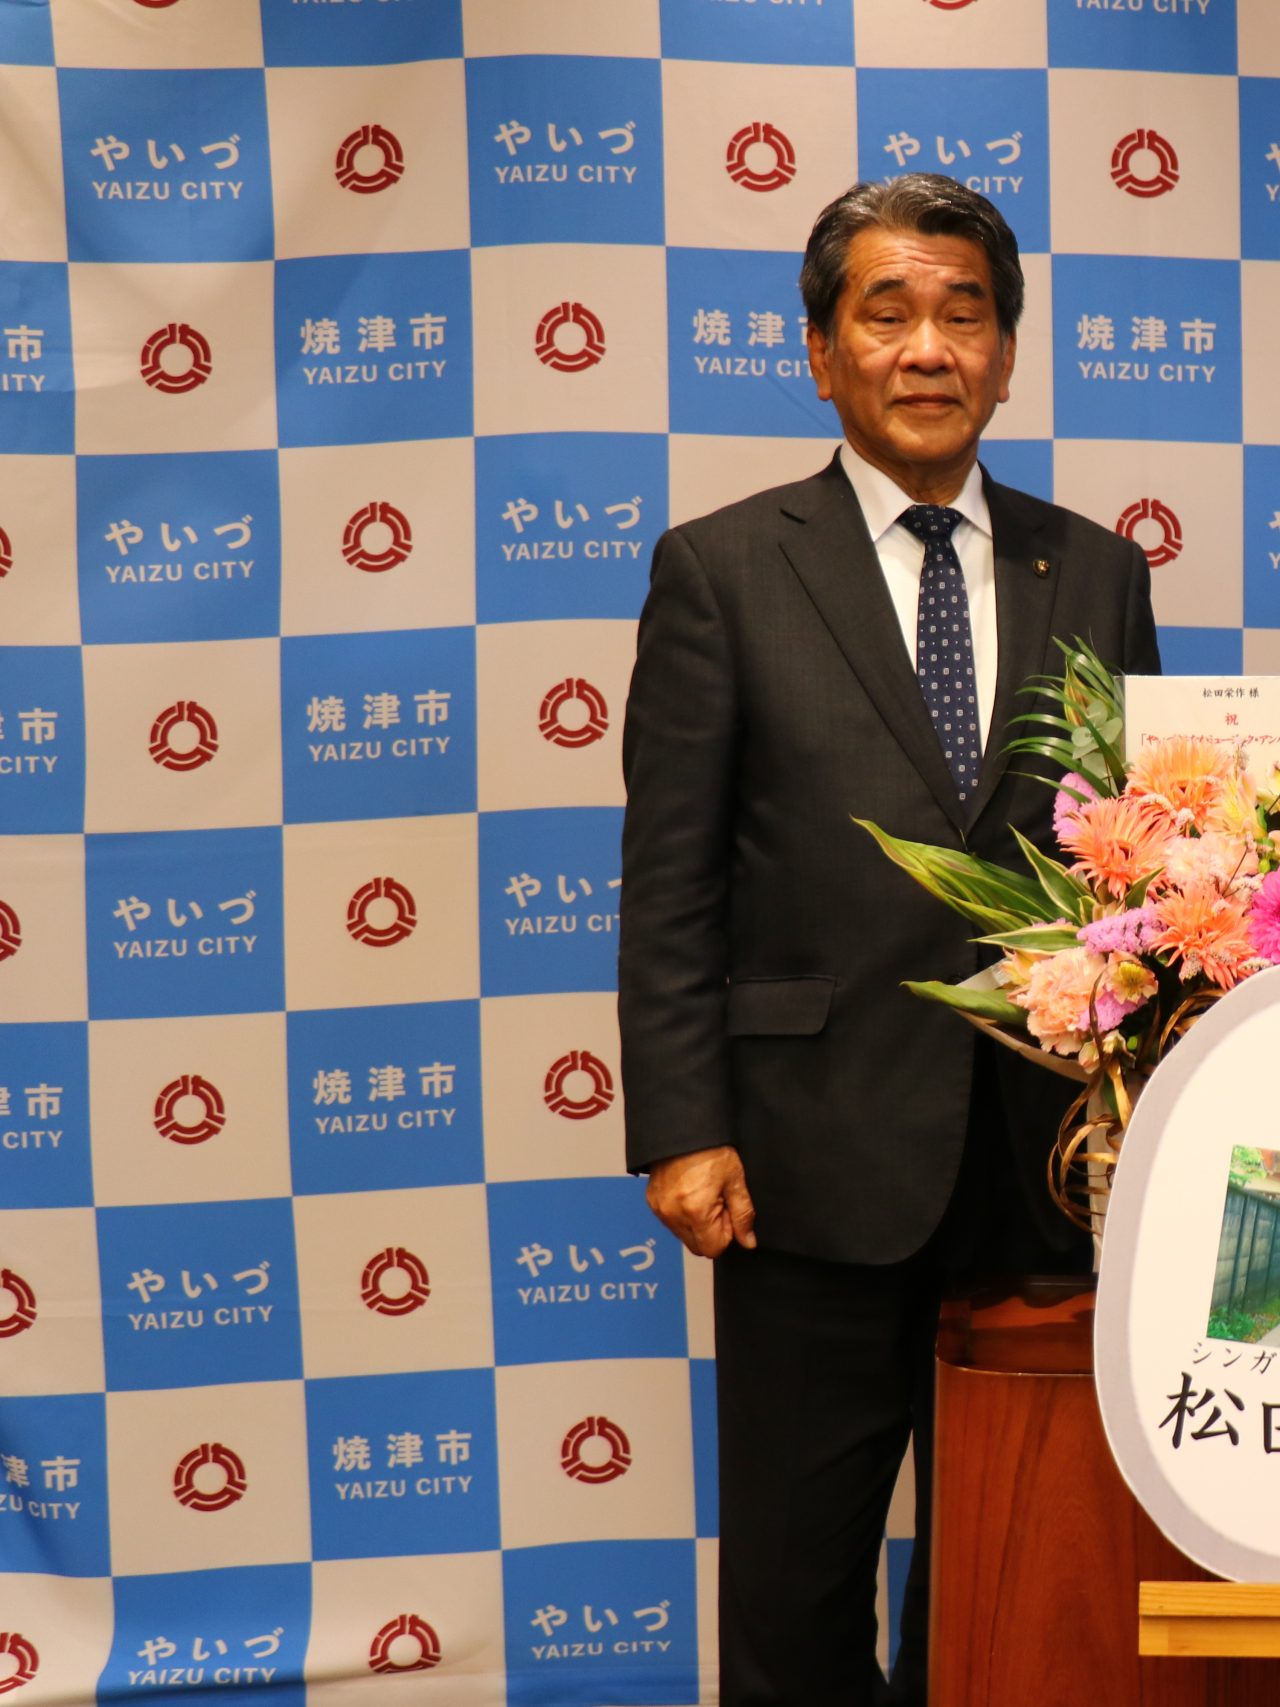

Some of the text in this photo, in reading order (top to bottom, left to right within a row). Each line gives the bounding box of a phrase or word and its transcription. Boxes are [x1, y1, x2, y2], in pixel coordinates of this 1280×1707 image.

[495, 121, 637, 156] やいづ
[883, 131, 1023, 167] やいづ
[91, 135, 241, 172] やいづ
[495, 165, 637, 184] YAIZU CITY
[966, 176, 1023, 194] CITY
[92, 181, 244, 200] YAIZU CITY
[300, 314, 448, 356] 焼津市
[1077, 315, 1216, 355] 焼津市
[303, 361, 446, 385] YAIZU CITY
[694, 356, 766, 377] YAIZU
[1078, 362, 1216, 383] YAIZU CITY
[501, 495, 643, 534] やいづ
[105, 515, 253, 556] やいづ
[501, 541, 642, 561] YAIZU CITY
[105, 561, 254, 584] YAIZU CITY
[1202, 687, 1245, 699] 松田栄作
[306, 689, 452, 733] 焼津市
[1224, 712, 1239, 726] 祝
[309, 737, 450, 762] YAIZU CITY
[0, 756, 58, 774] CITY
[504, 873, 622, 908] やい
[112, 890, 257, 932] やいづ
[505, 916, 577, 936] YAIZU
[113, 936, 257, 959] YAIZU CITY
[312, 1061, 456, 1105] 焼津市
[315, 1109, 456, 1134] YAIZU CITY
[2, 1130, 63, 1149] CITY
[515, 1239, 657, 1278] やいづ
[127, 1261, 271, 1304] やいづ
[517, 1283, 658, 1305] YAIZU CITY
[128, 1306, 273, 1331] YAIZU CITY
[332, 1430, 472, 1472] 焼津市
[335, 1476, 472, 1500] YAIZU CITY
[28, 1501, 81, 1520] CITY
[530, 1600, 671, 1638] やいづ
[137, 1627, 285, 1667] やいづ
[531, 1641, 671, 1660] YAIZU CITY
[127, 1666, 277, 1686] YAIZU CITY
